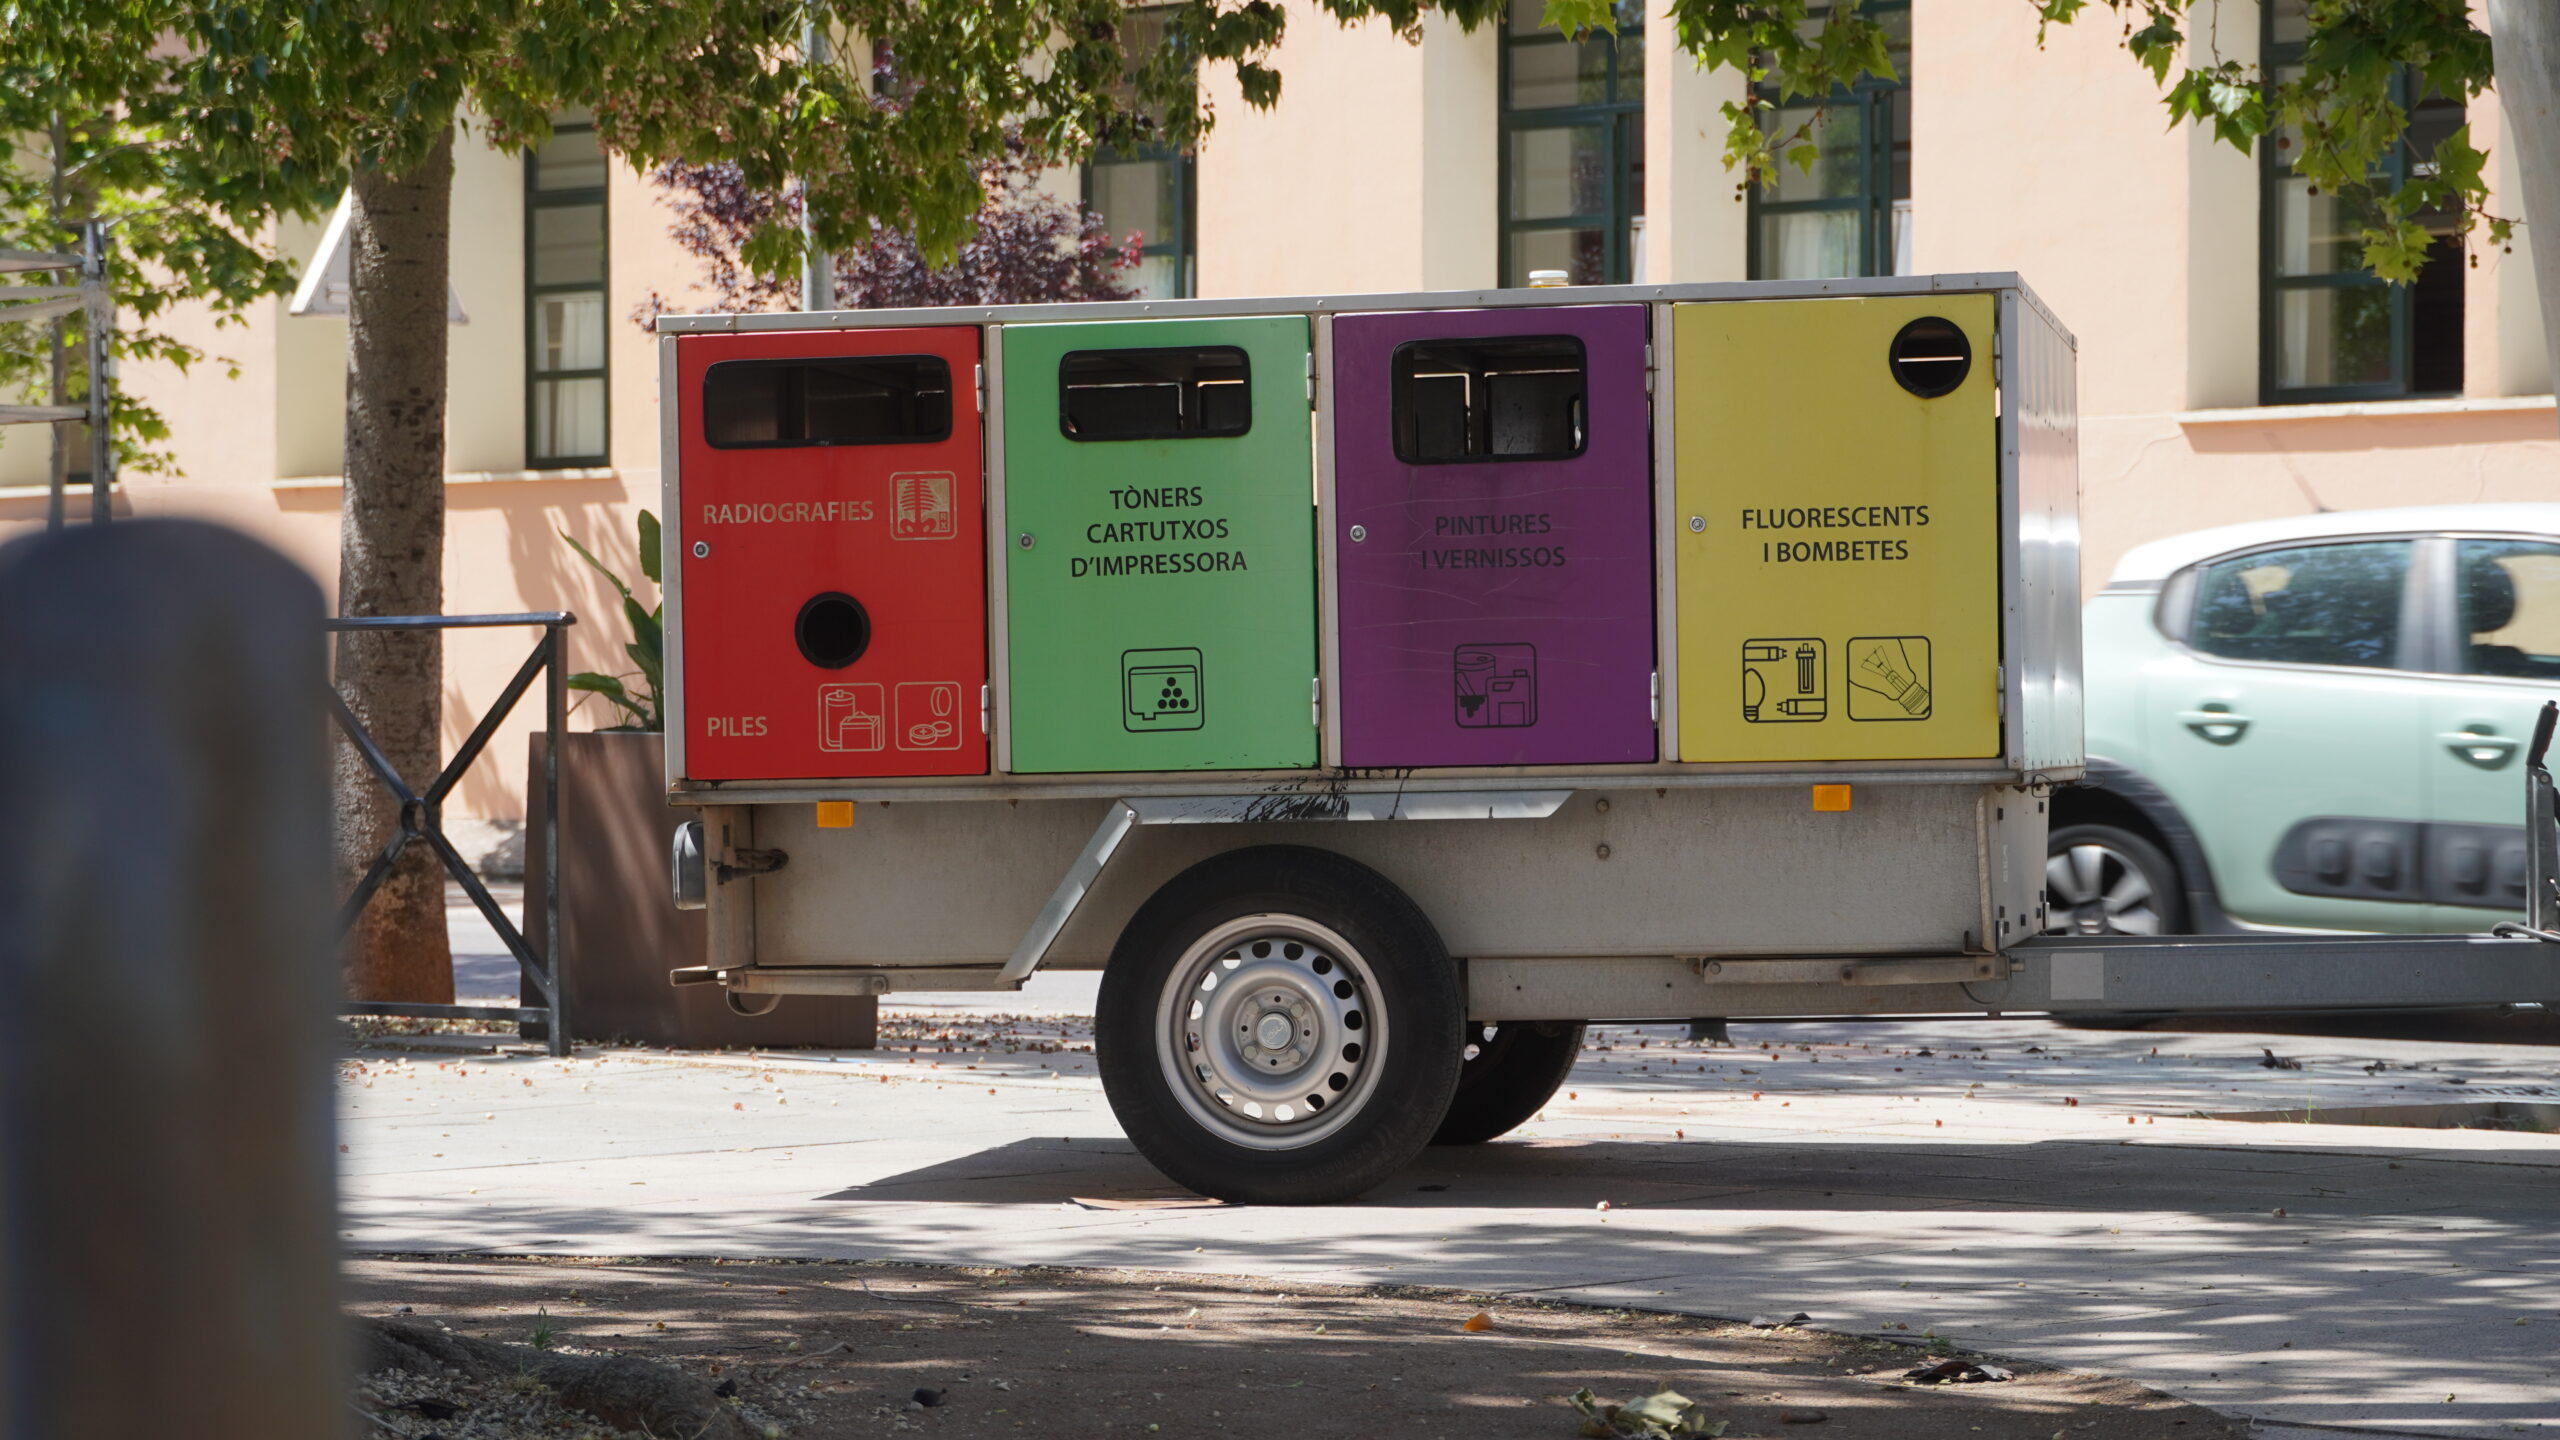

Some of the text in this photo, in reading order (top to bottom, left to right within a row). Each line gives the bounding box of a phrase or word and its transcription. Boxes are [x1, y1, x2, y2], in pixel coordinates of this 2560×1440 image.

[1110, 485, 1203, 510] TÒNERS
[704, 501, 874, 525] RADIOGRAFIES
[1436, 513, 1550, 535] PINTURES
[1743, 505, 1930, 530] FLUORESCENTS
[1087, 518, 1229, 544] CARTUTXOS
[1422, 546, 1566, 570] I VERNISSOS
[1764, 540, 1909, 563] I BOMBETES
[707, 716, 768, 737] PILES
